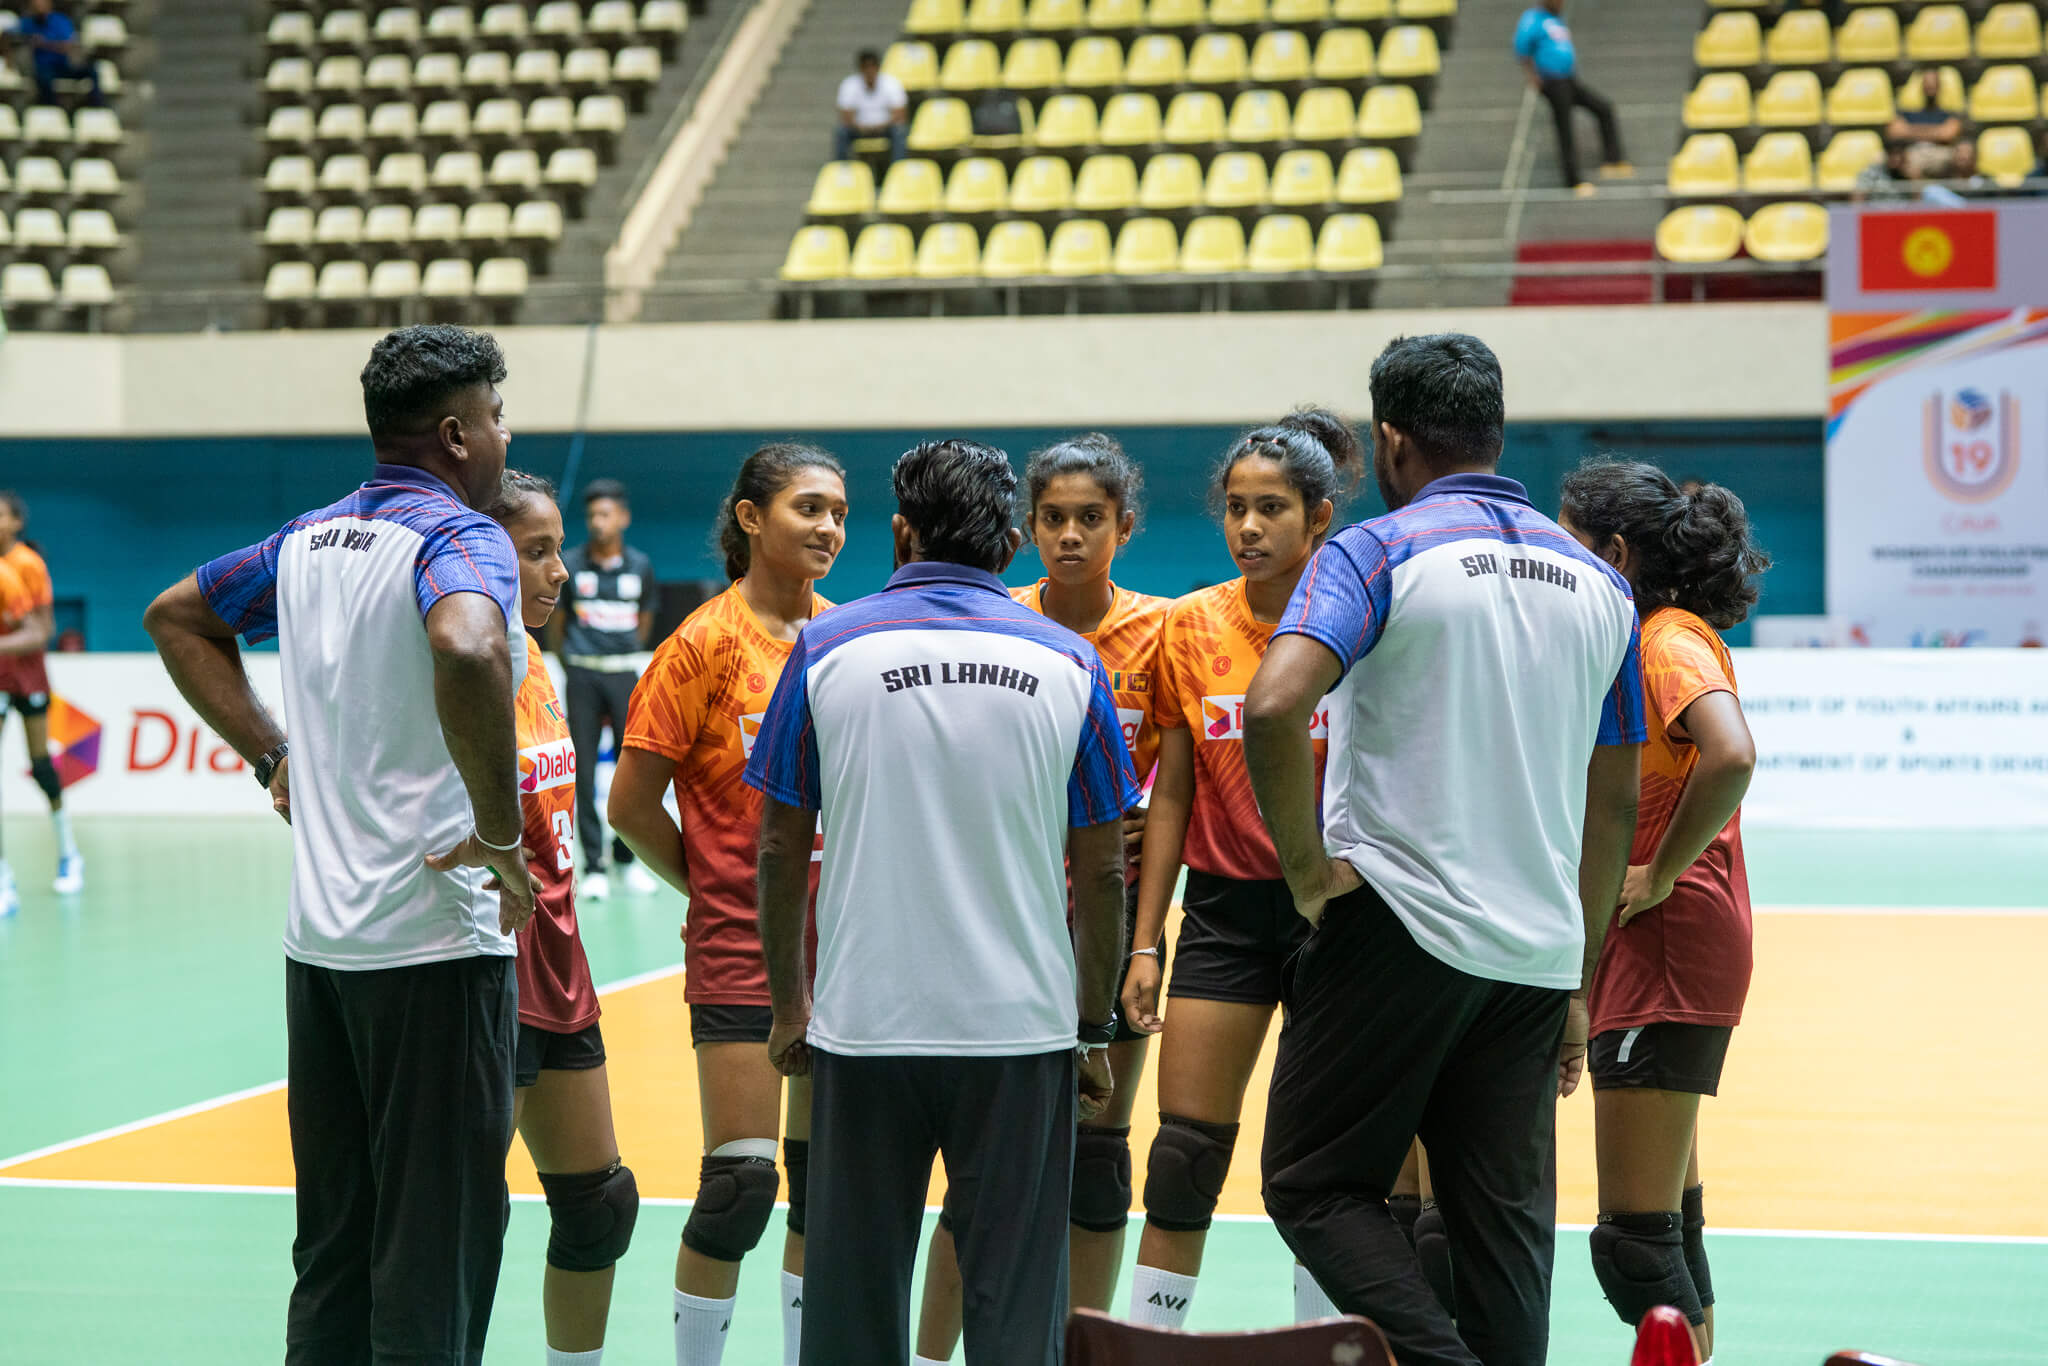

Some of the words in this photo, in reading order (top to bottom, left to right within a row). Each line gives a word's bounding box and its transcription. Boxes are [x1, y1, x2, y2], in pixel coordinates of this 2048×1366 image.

[1951, 440, 1994, 474] 19
[1460, 553, 1498, 578] SRI
[880, 664, 932, 693] SRI
[940, 662, 1040, 697] LANKA
